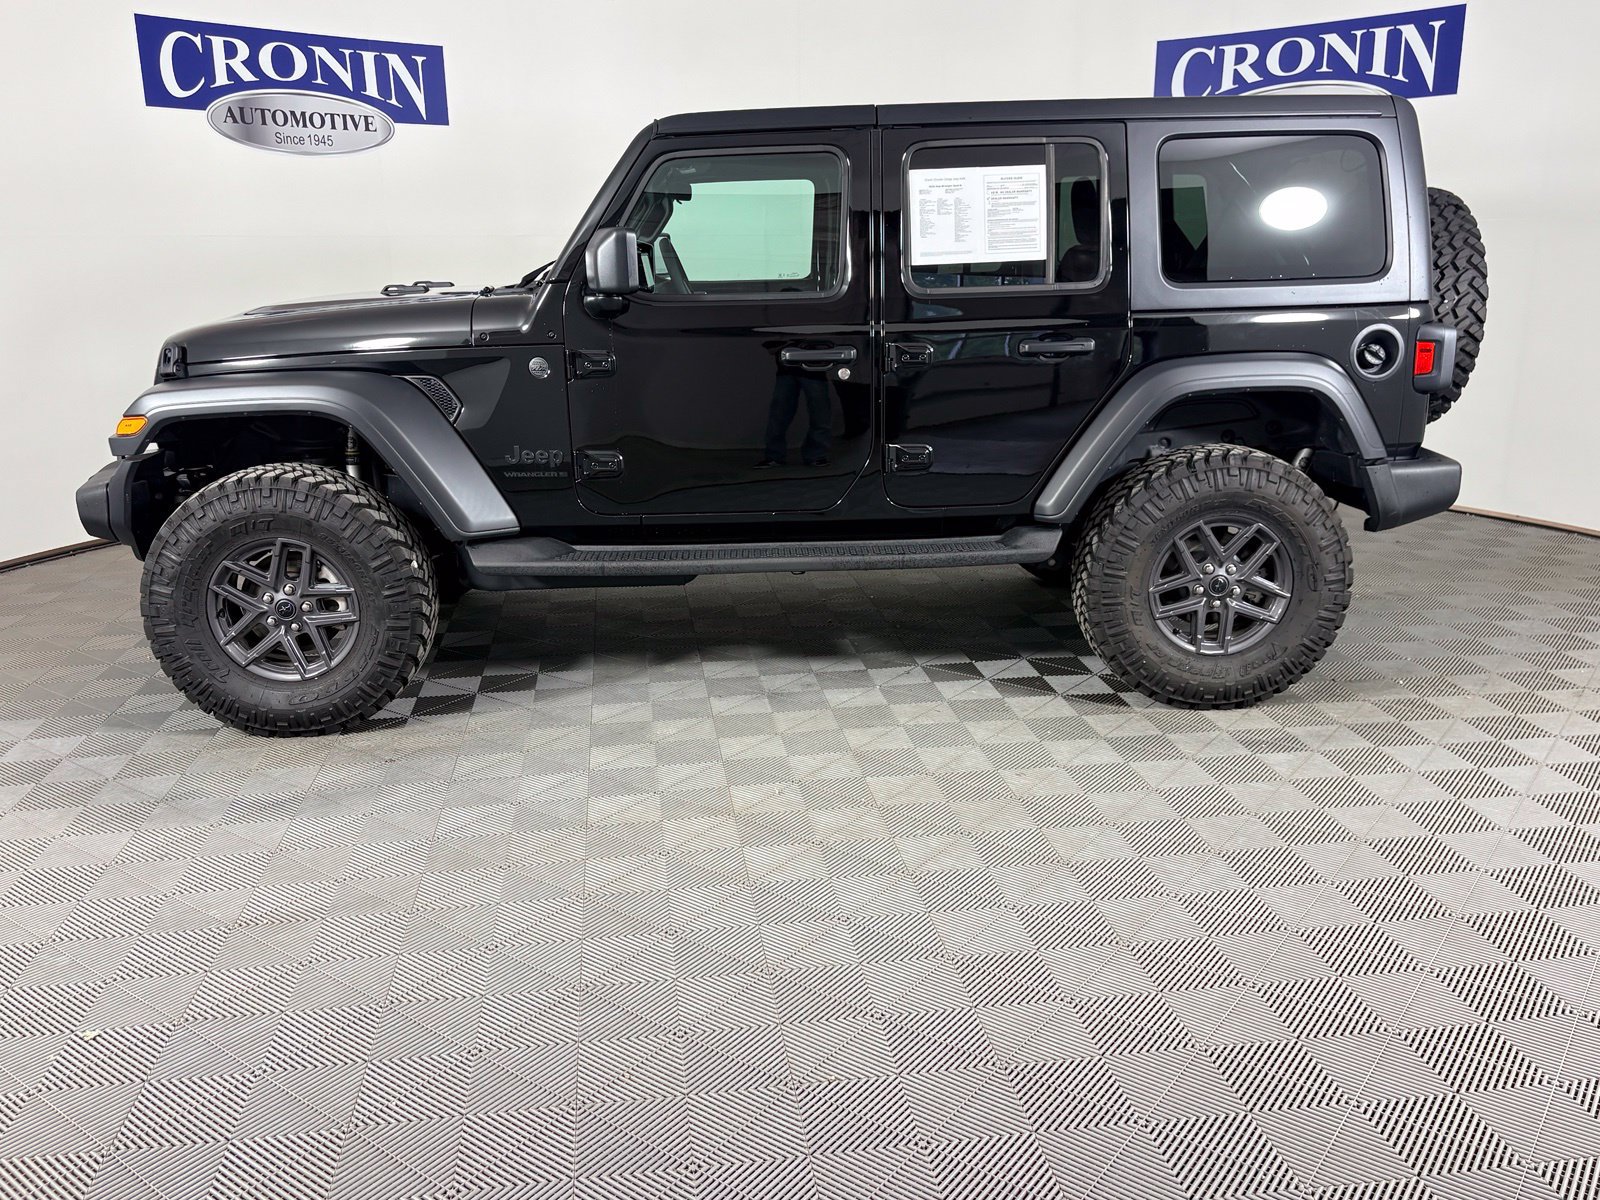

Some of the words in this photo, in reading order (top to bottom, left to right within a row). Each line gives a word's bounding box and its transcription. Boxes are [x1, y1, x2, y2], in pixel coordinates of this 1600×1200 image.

[1171, 20, 1446, 97] CRONIN
[159, 31, 427, 120] CRONIN
[223, 106, 378, 133] AUTOMOTIVE
[274, 132, 305, 146] Since
[307, 134, 334, 147] 1945
[504, 445, 564, 468] Jeep
[503, 471, 558, 479] WRANGLER
